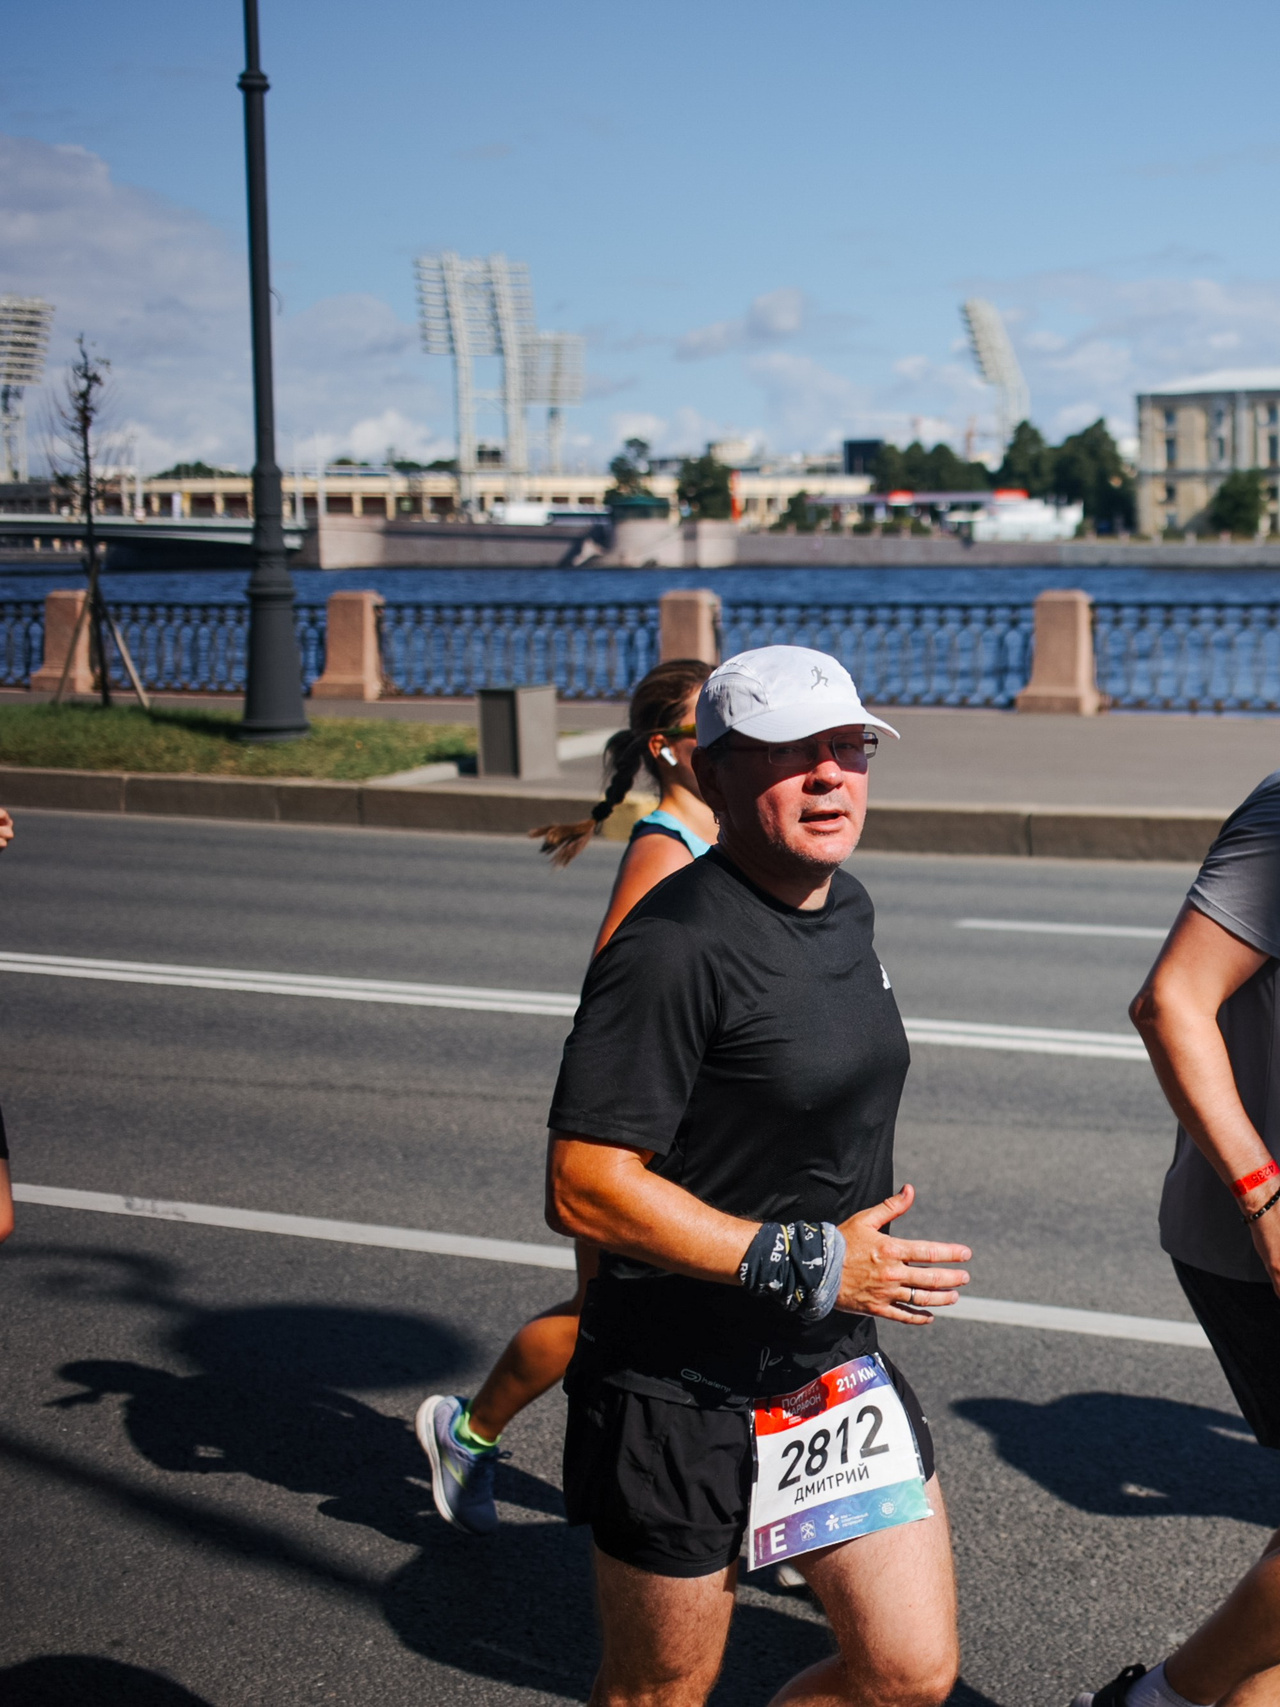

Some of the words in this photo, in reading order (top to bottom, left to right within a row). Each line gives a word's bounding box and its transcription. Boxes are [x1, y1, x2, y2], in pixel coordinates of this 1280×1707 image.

[1251, 1164, 1274, 1183] 4235
[770, 1232, 785, 1263] LAB
[836, 1373, 858, 1393] 21,1
[782, 1394, 822, 1419] МАРАФОН
[778, 1405, 890, 1491] 2812
[794, 1463, 870, 1505] ДМИТРИЙ
[770, 1523, 787, 1555] E
